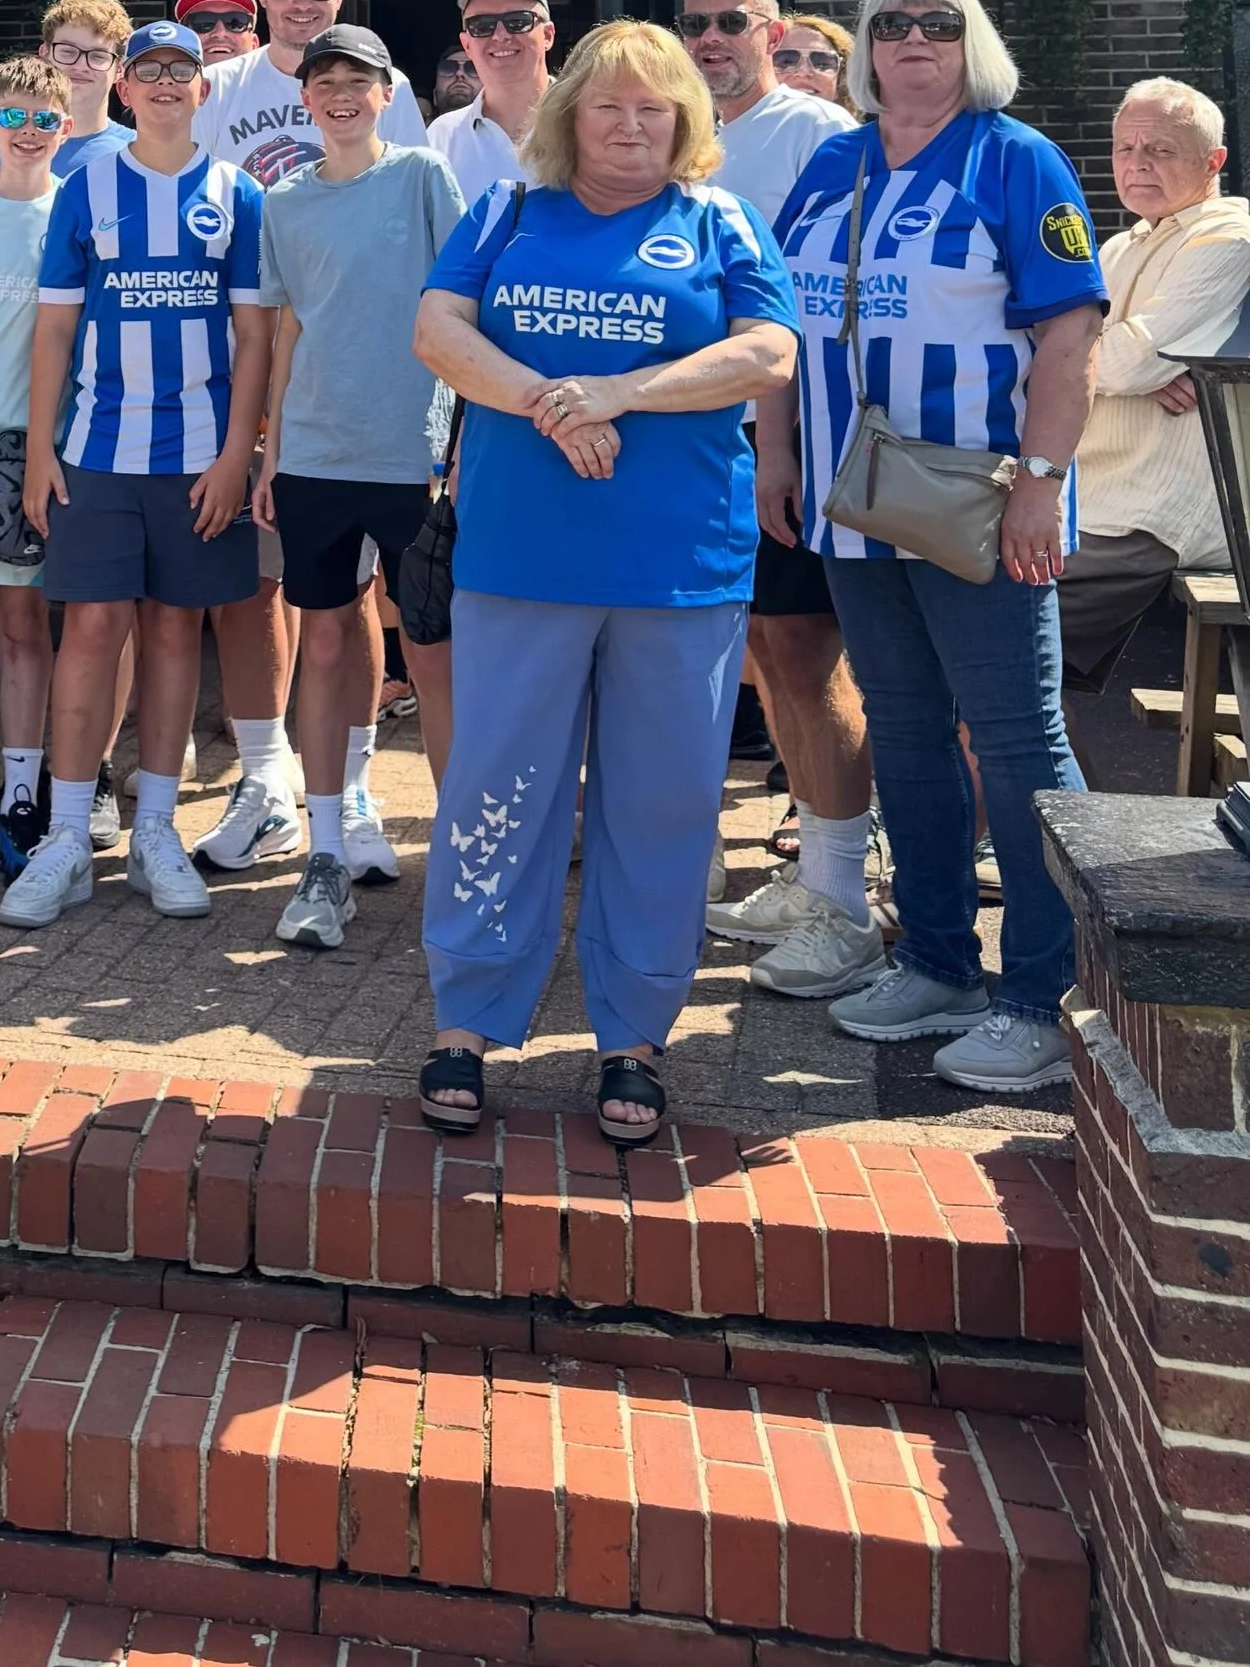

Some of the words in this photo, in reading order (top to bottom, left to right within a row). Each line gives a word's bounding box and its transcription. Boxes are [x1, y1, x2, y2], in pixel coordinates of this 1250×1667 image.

[229, 104, 314, 145] MAVE
[104, 270, 218, 289] AMERICAN
[120, 289, 218, 308] EXPRESS
[493, 284, 667, 319] AMERICAN
[513, 310, 666, 344] EXPRESS
